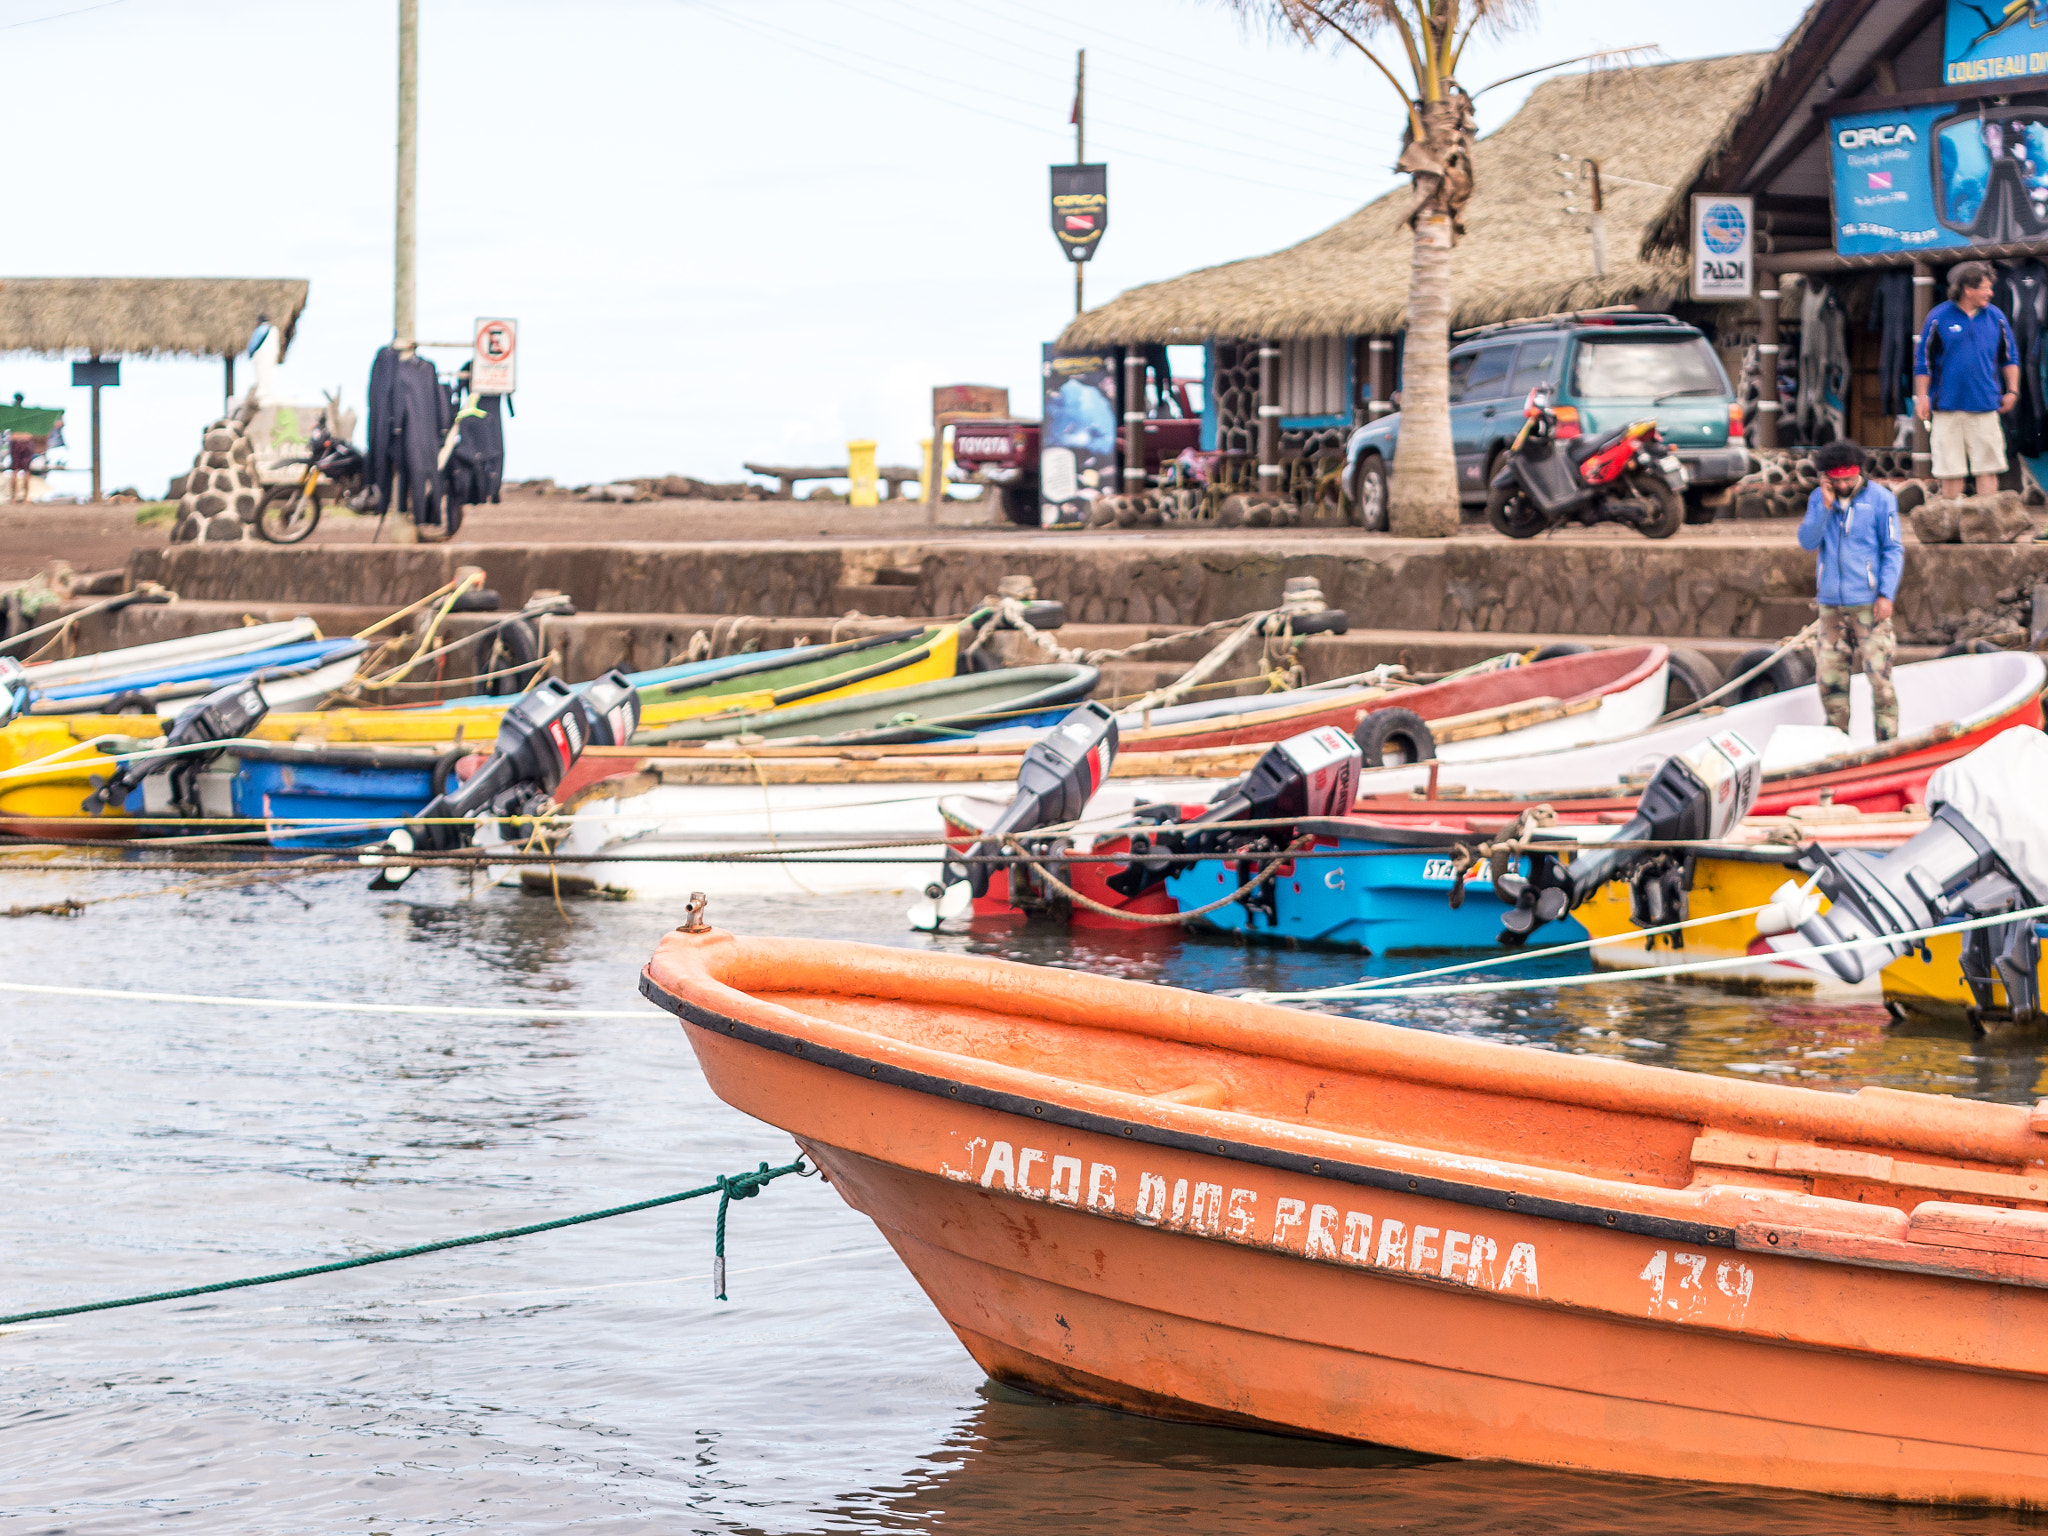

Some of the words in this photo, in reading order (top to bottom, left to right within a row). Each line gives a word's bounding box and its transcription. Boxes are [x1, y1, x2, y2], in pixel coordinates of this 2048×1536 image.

[1839, 124, 1917, 149] ORCA
[1703, 261, 1744, 279] PADI
[958, 437, 1009, 455] TOYOTA
[1640, 1250, 1754, 1325] 139
